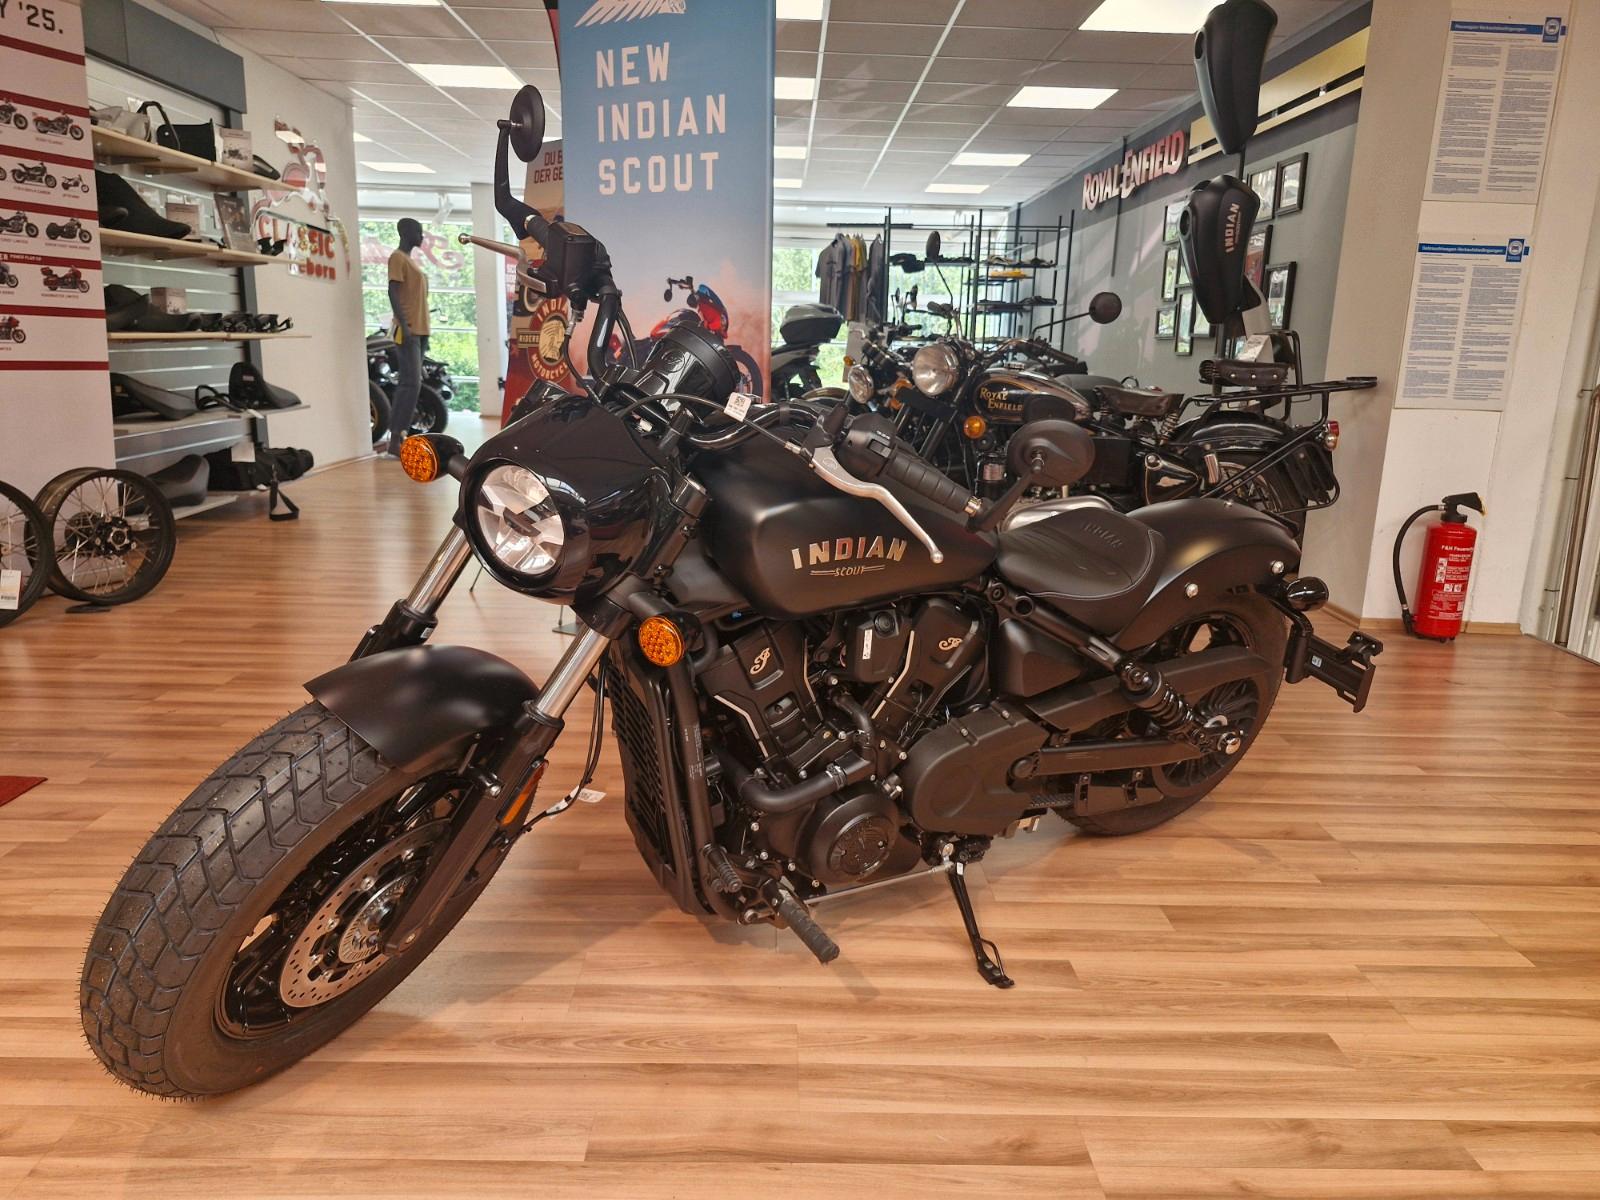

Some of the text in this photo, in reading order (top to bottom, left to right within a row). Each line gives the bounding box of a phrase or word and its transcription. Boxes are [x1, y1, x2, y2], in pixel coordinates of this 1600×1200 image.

[18, 1, 64, 34] '25.
[596, 42, 670, 89] NEW
[596, 93, 727, 143] INDIAN
[544, 151, 556, 166] DU
[1081, 130, 1186, 211] ROYAL ENFIELD
[534, 168, 551, 184] DER
[598, 151, 720, 196] SCOUT
[1224, 202, 1240, 253] INDIAN
[537, 297, 568, 322] INDIA
[531, 354, 568, 380] MOTORCYCL
[979, 387, 1009, 401] ROYAL
[987, 398, 1023, 411] ENFIELD
[791, 535, 908, 570] INDIAN
[834, 565, 865, 577] SCOUT
